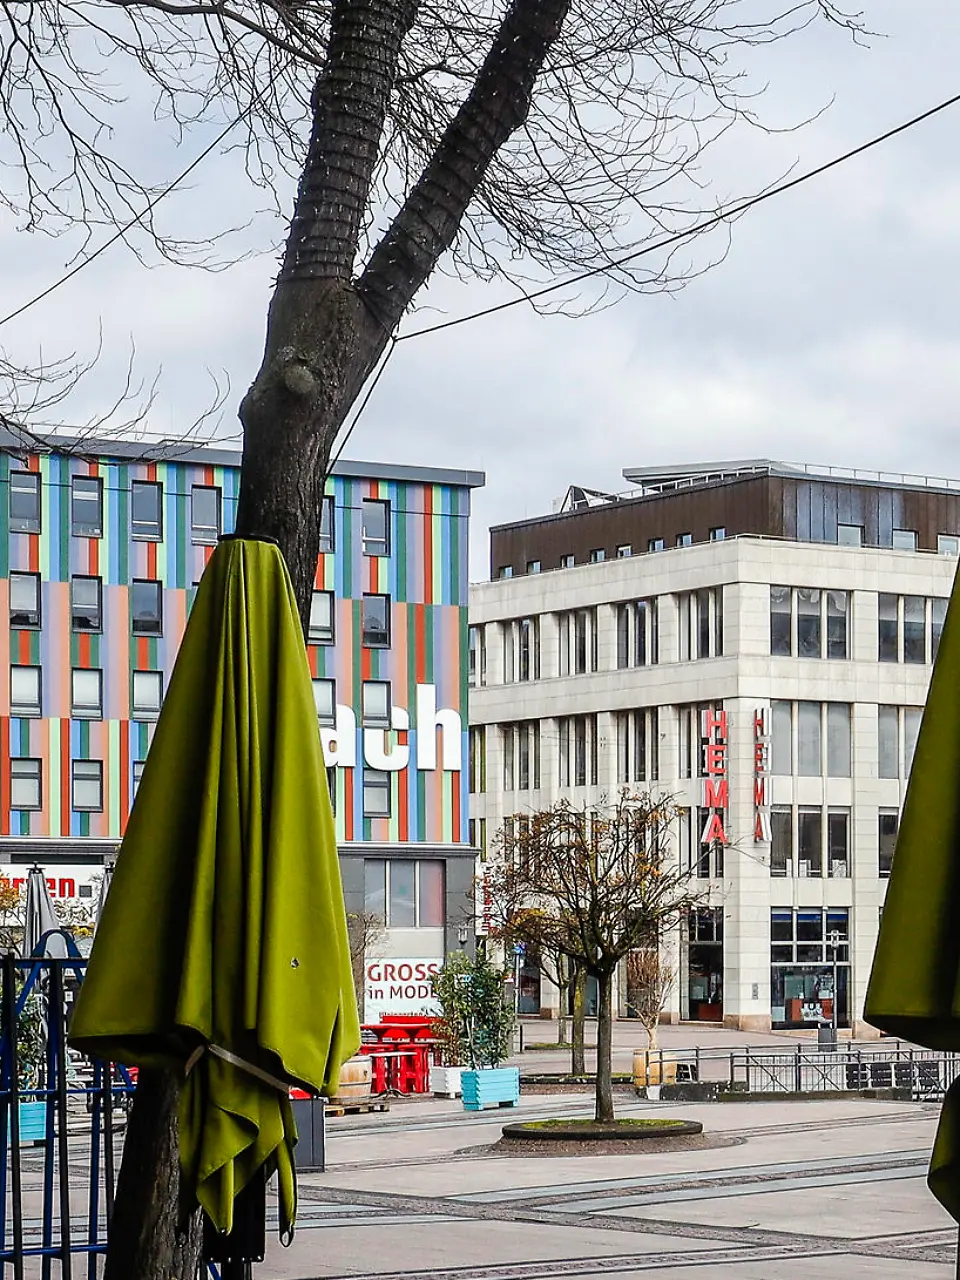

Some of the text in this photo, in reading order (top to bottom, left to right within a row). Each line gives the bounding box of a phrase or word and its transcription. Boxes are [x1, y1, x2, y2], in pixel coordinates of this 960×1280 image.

[703, 709, 728, 843] HEMA
[754, 708, 768, 842] HEMA
[368, 985, 384, 999] in
